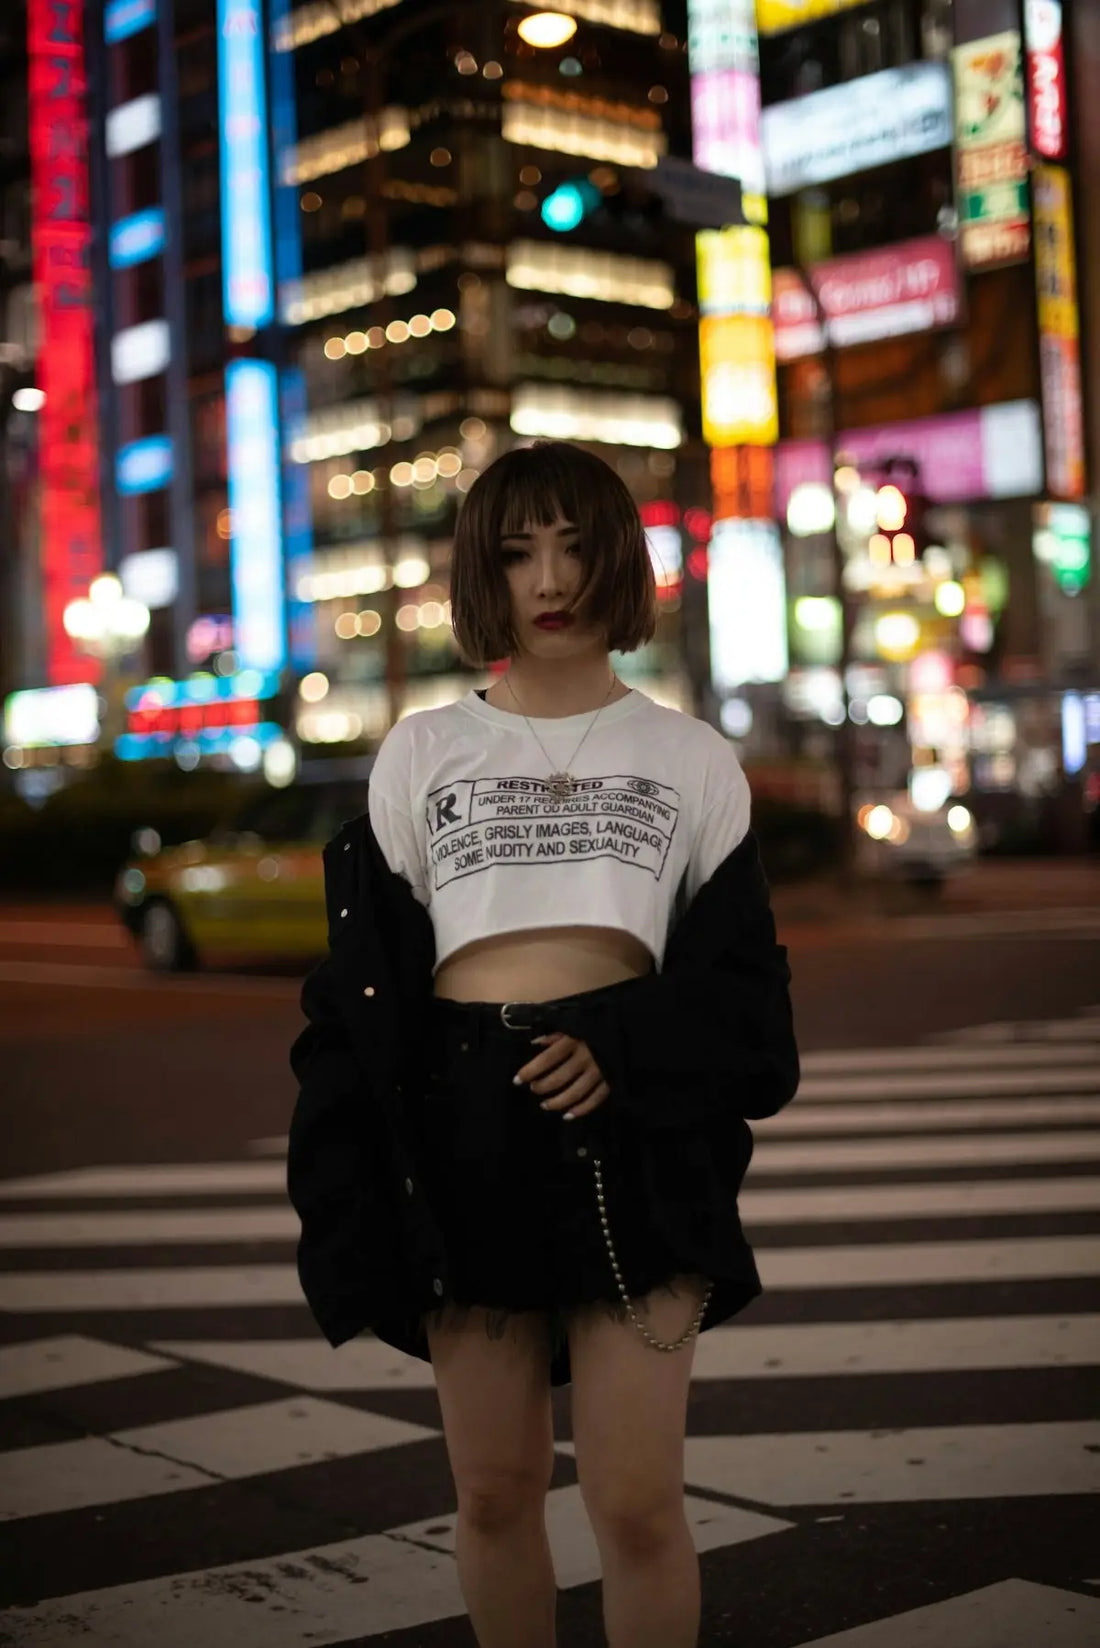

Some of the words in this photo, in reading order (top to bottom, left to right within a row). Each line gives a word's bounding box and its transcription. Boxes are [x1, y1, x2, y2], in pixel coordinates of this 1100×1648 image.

[435, 792, 462, 832] R
[478, 795, 515, 806] UNDER
[519, 795, 530, 803] 17
[592, 792, 671, 820] ACCOMPANYING
[496, 804, 540, 816] PARENT
[562, 801, 599, 813] ADULT
[601, 803, 655, 824] GUARDIAN
[484, 824, 533, 841] GRISLY
[536, 821, 593, 838] IMAGES,
[454, 848, 484, 871] SOME
[486, 842, 535, 860] NUDITY
[536, 841, 566, 857] AND
[569, 837, 641, 859] SEXUALITY
